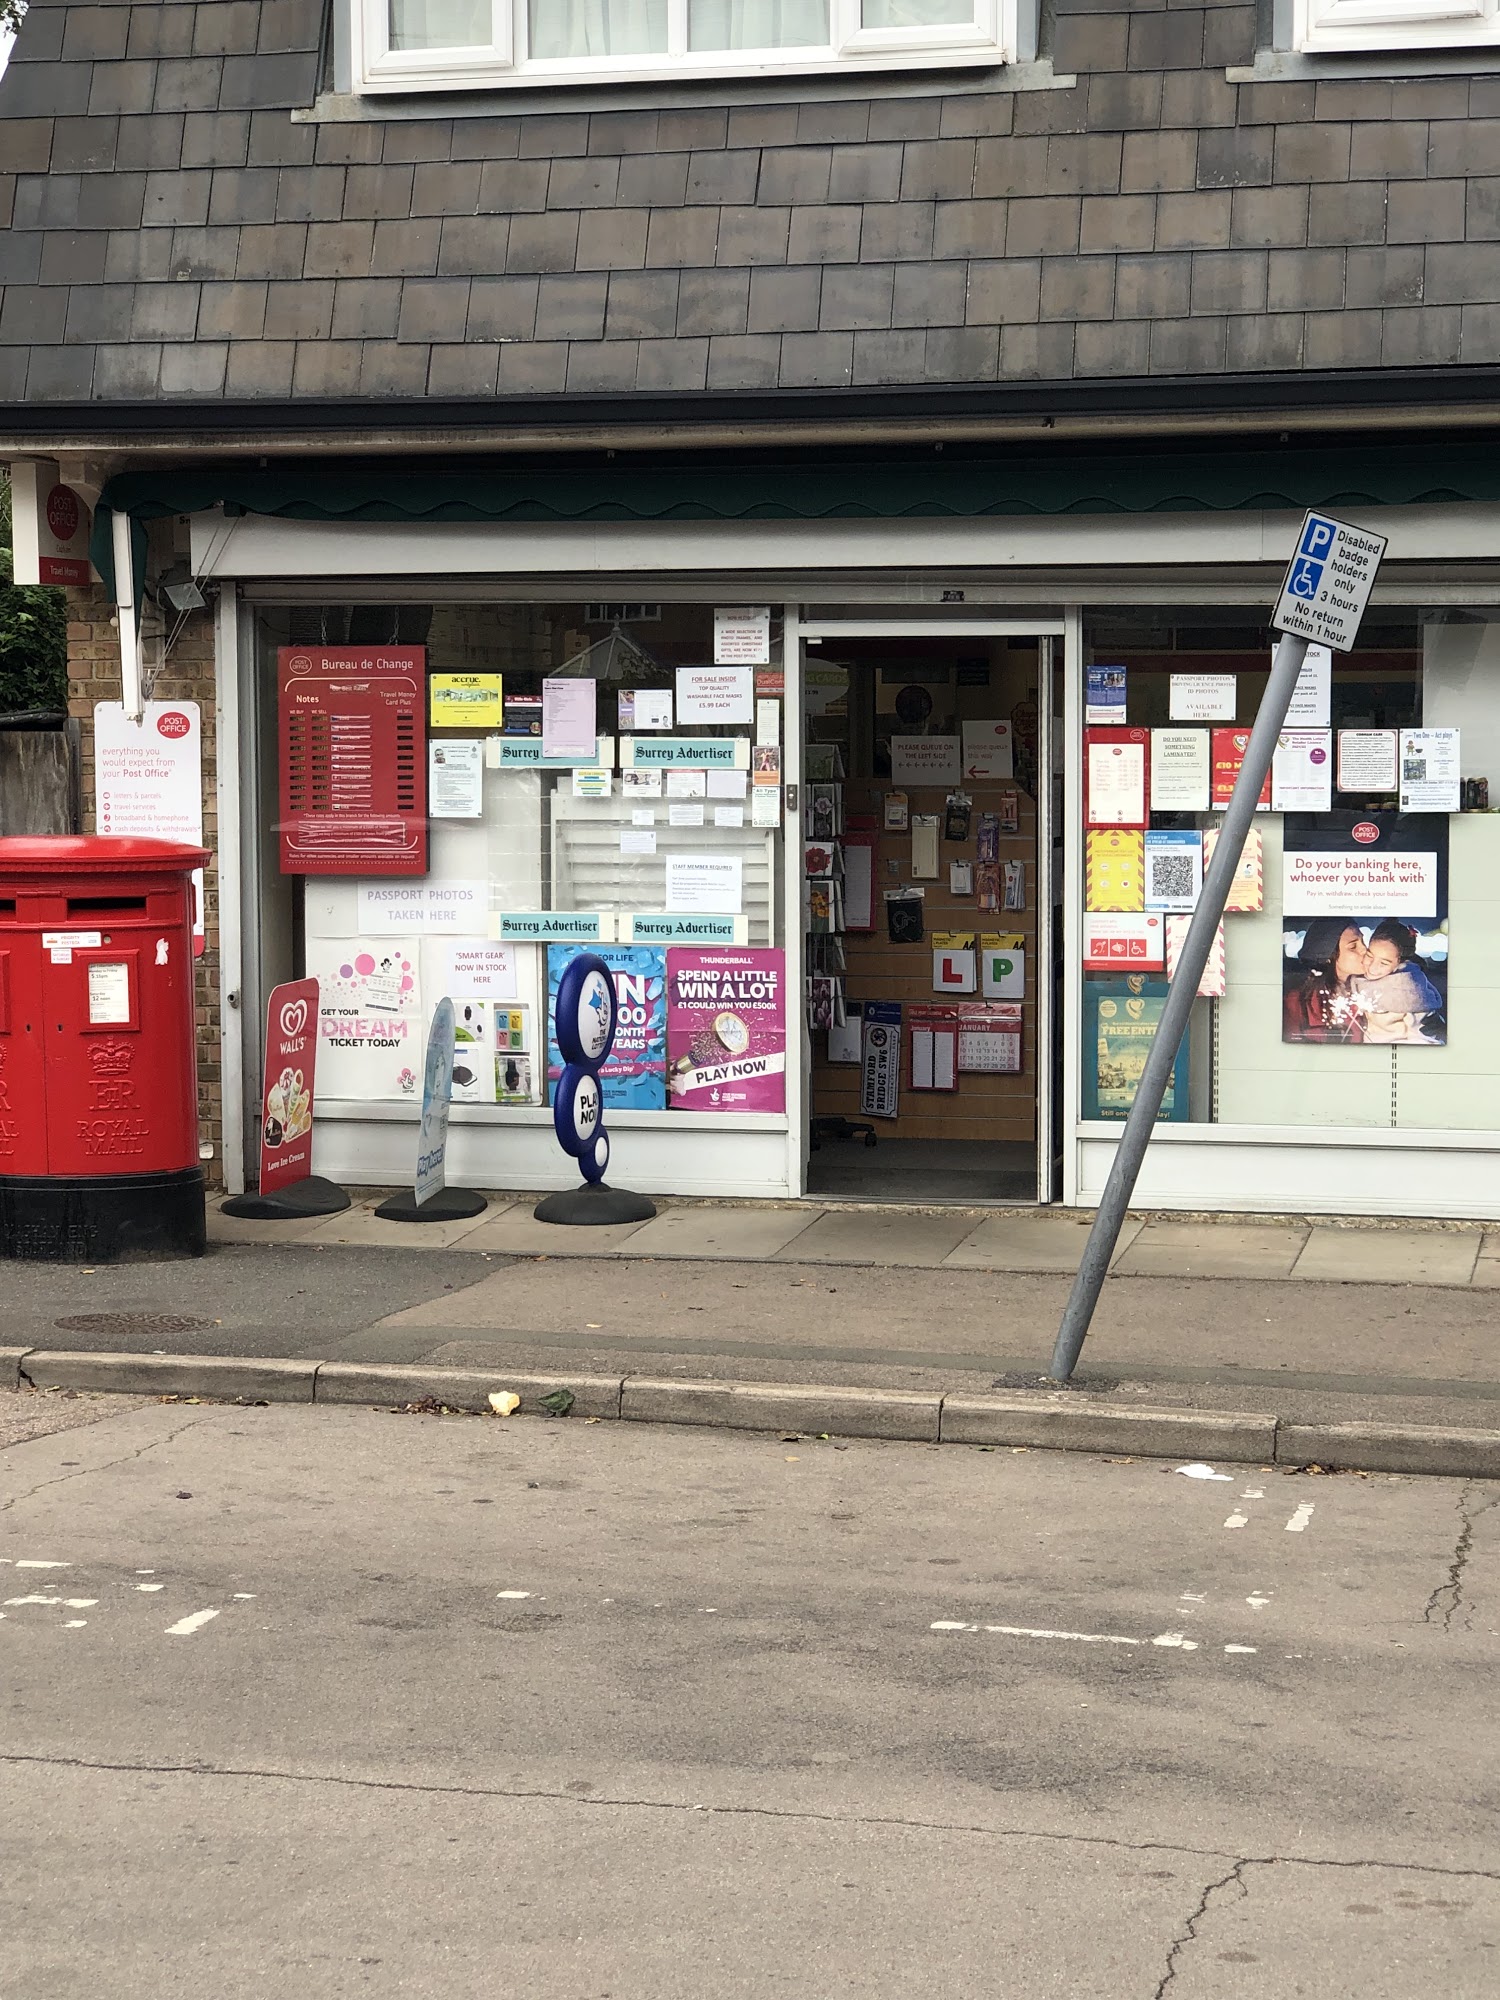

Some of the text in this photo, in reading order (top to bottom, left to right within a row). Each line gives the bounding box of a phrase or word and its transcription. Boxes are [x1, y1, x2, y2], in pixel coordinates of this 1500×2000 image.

[54, 496, 72, 510] POST
[50, 512, 76, 528] OFFICE
[1308, 524, 1330, 553] P
[1338, 530, 1380, 554] Disabled
[1339, 546, 1368, 566] badge
[50, 565, 64, 576] Travel
[1331, 560, 1368, 581] holders
[1334, 578, 1356, 594] only
[1321, 591, 1359, 612] 3 hours
[1295, 602, 1343, 627] No return
[1283, 615, 1347, 643] within 1 hour
[322, 658, 413, 670] Bureau de Change
[102, 747, 143, 757] everything
[502, 746, 540, 760] Surrey
[635, 747, 733, 760] Surrey Advertiser
[128, 759, 154, 769] expect
[123, 769, 141, 777] Post
[1296, 858, 1422, 872] Do your banking here,
[1290, 873, 1341, 883] whoever
[1344, 874, 1364, 885] you
[1368, 872, 1395, 883] bank
[367, 890, 473, 901] PASSPORT PHOTOS
[388, 910, 457, 920] TAKEN HERE
[502, 920, 598, 936] Surrey Advertiser
[634, 921, 732, 935] Surrey Advertiser
[1013, 941, 1024, 949] AA
[677, 970, 777, 982] SPEND A LITTLE
[943, 958, 962, 983] L
[993, 958, 1013, 982] P
[678, 982, 777, 999] WIN A LOT
[321, 1018, 408, 1038] DREAM
[615, 1027, 645, 1036] ONTH
[1102, 1027, 1130, 1035] FREE
[329, 1038, 400, 1047] TICKET TODAY
[696, 1060, 766, 1083] PLAY NOW
[877, 1049, 888, 1110] BRIDGE SW6
[866, 1055, 876, 1108] STAMFORD
[77, 1120, 149, 1137] ROYAL
[86, 1138, 143, 1155] MAIL
[268, 1161, 280, 1172] Love
[289, 1152, 305, 1165] Cream
